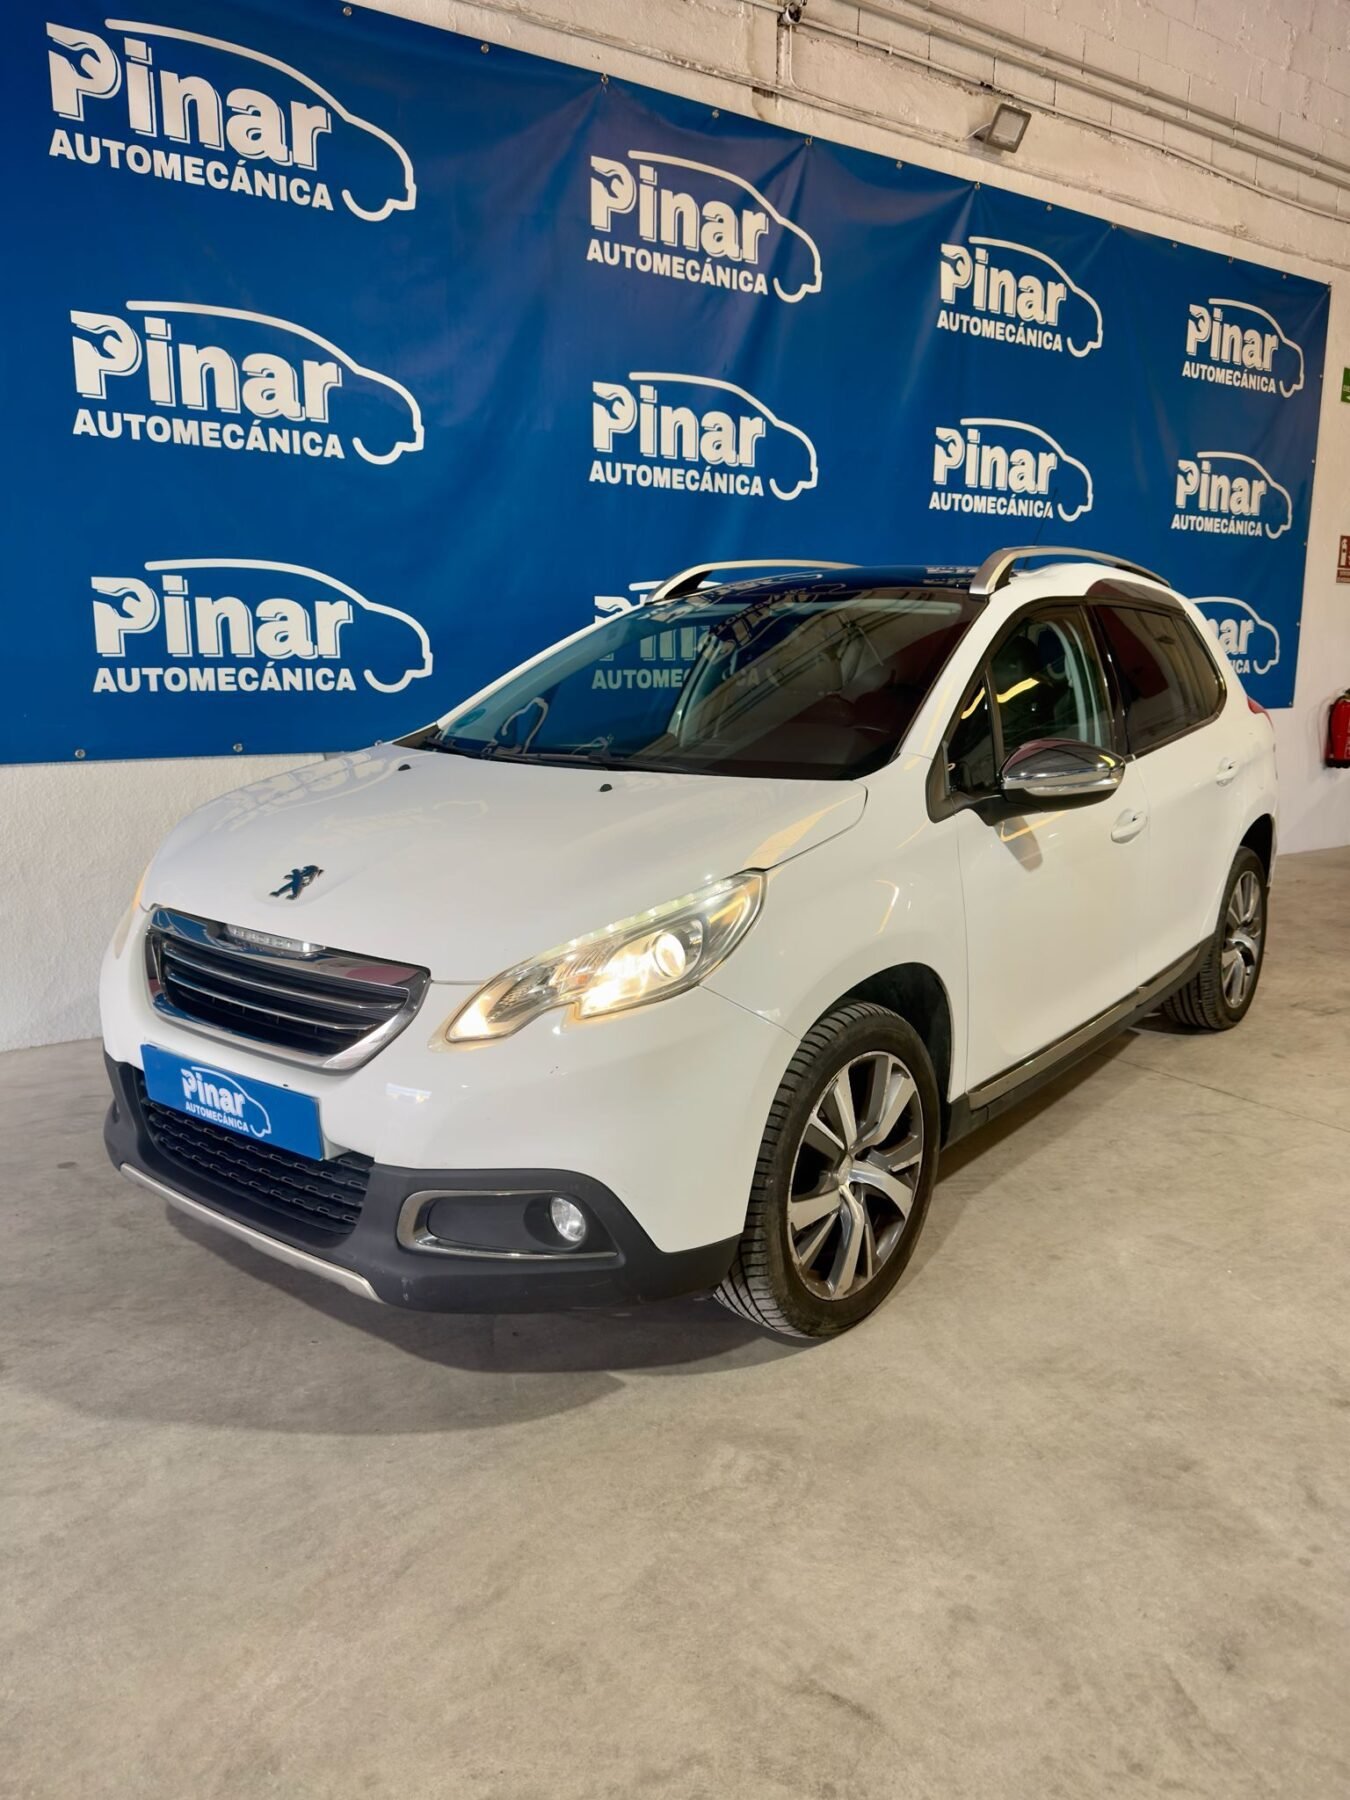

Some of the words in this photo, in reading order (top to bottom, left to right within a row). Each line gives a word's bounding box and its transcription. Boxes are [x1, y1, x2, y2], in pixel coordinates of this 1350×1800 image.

[46, 22, 331, 170] Pinar
[48, 129, 334, 211] AUTOMECÁNICA
[590, 156, 770, 265] Pinar
[586, 238, 769, 295] AUTOMECÁNICA
[940, 243, 1066, 326] Pinar
[936, 309, 1063, 353] AUTOMECÁNICA
[1186, 304, 1279, 372] Pinar
[70, 310, 342, 423] Pinar
[1182, 360, 1277, 394] AUTOMECÁNICA
[72, 408, 345, 459] AUTOMECÁNICA
[592, 382, 766, 468] Pinar
[588, 460, 764, 497] AUTOMECÁNICA
[933, 427, 1058, 495] Pinar
[1175, 459, 1267, 516] Pinar
[928, 491, 1054, 519] AUTOMECÁNICA
[1170, 513, 1263, 537] AUTOMECÁNICA
[90, 575, 353, 660] Pinar
[92, 661, 357, 693] AUTOMECÁNICA
[181, 1068, 245, 1118] Pinar
[185, 1101, 250, 1133] AUTOMECÁNICA
